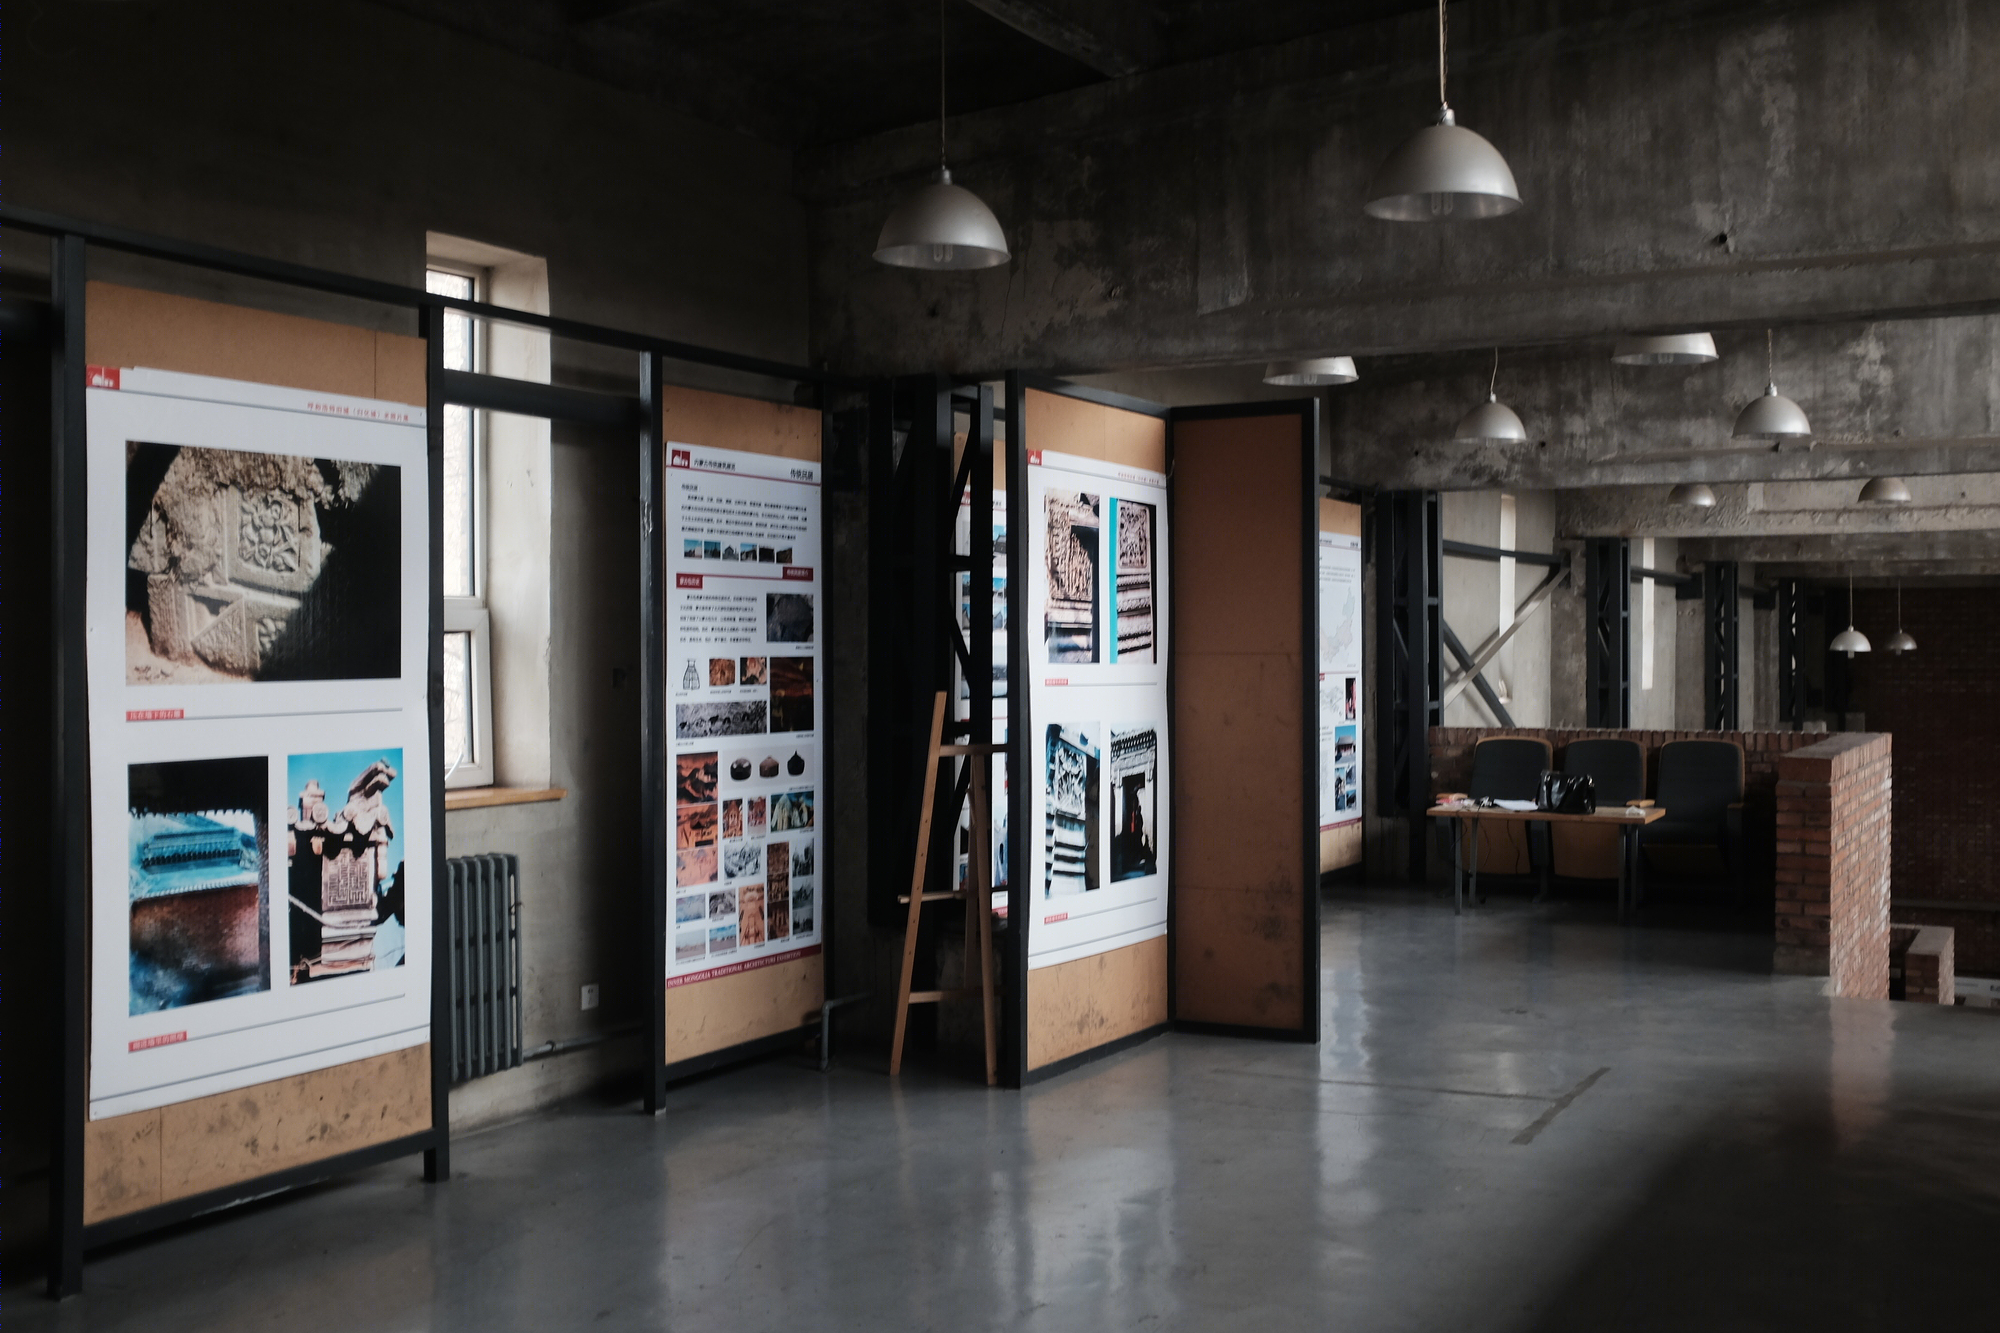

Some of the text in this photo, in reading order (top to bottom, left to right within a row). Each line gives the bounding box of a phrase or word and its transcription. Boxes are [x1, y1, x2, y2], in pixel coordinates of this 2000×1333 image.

[790, 468, 813, 481] 传统民居
[667, 978, 684, 988] INNER
[684, 972, 711, 984] MONGOLIA
[712, 965, 743, 977] TRADITIONAL
